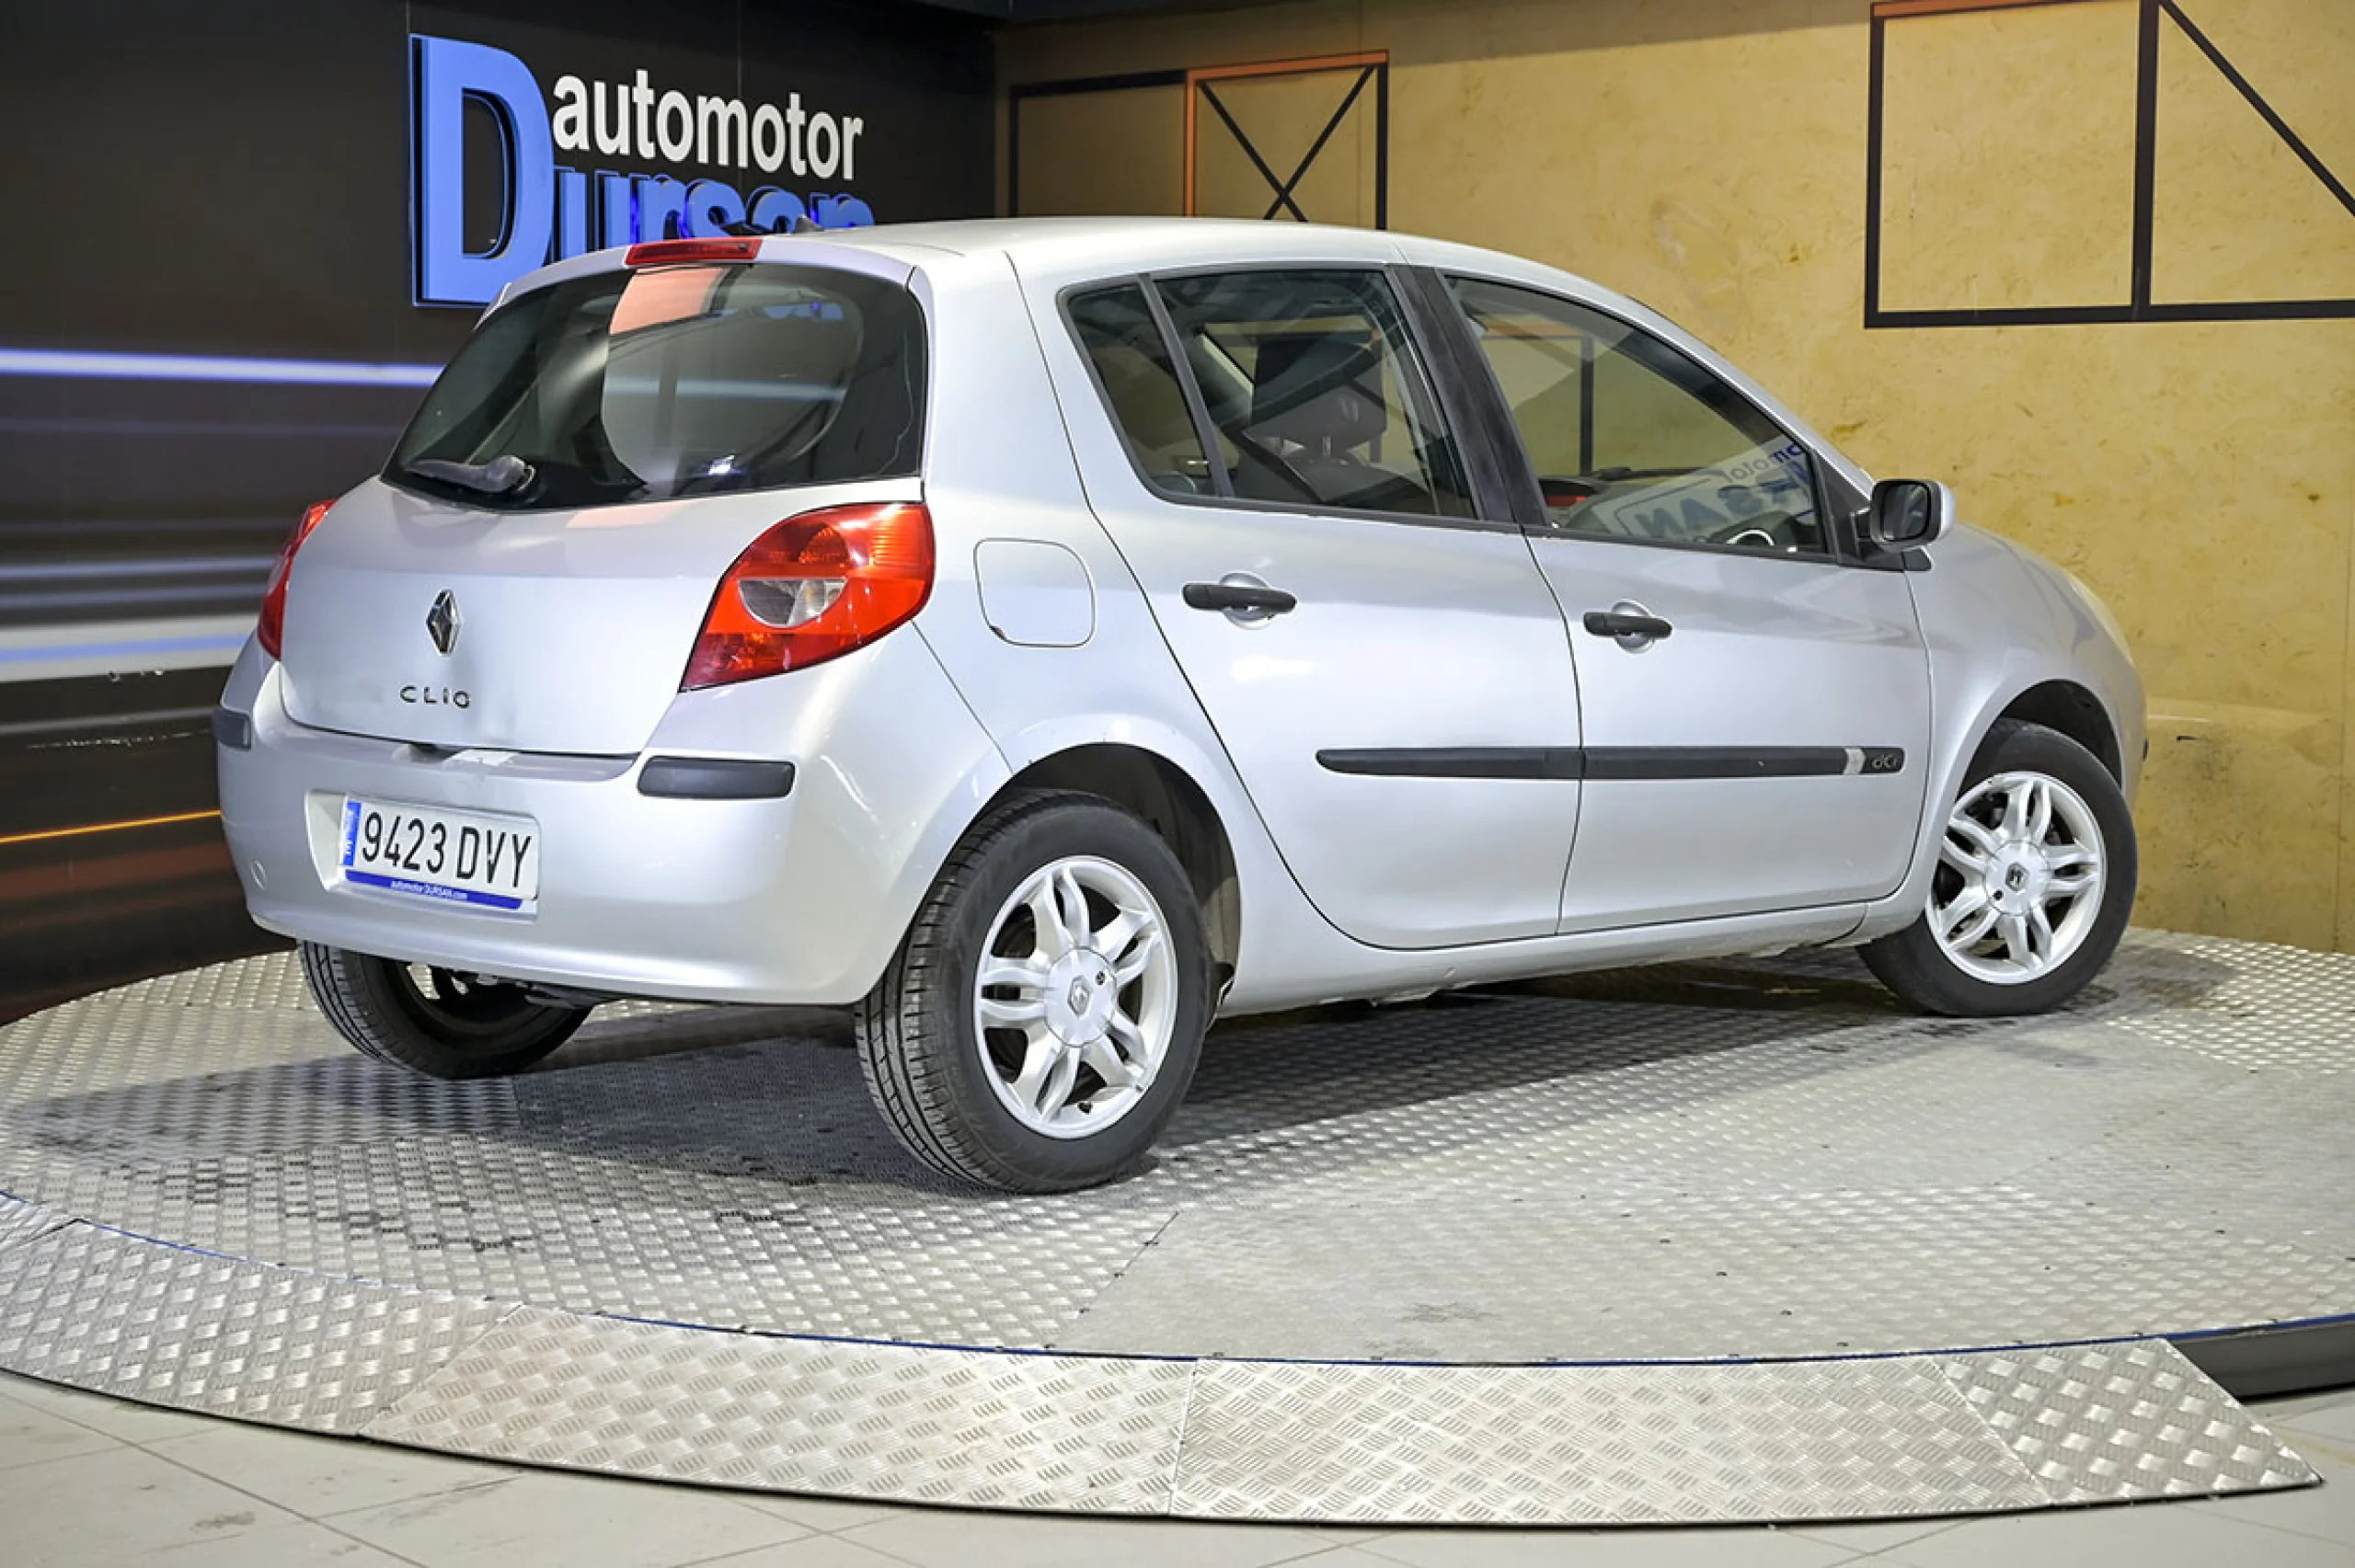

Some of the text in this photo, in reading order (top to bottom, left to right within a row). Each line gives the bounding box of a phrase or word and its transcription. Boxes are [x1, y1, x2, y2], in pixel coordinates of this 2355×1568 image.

[553, 69, 864, 180] automotor
[399, 684, 471, 709] CLIO
[362, 811, 533, 888] 9423 DVY
